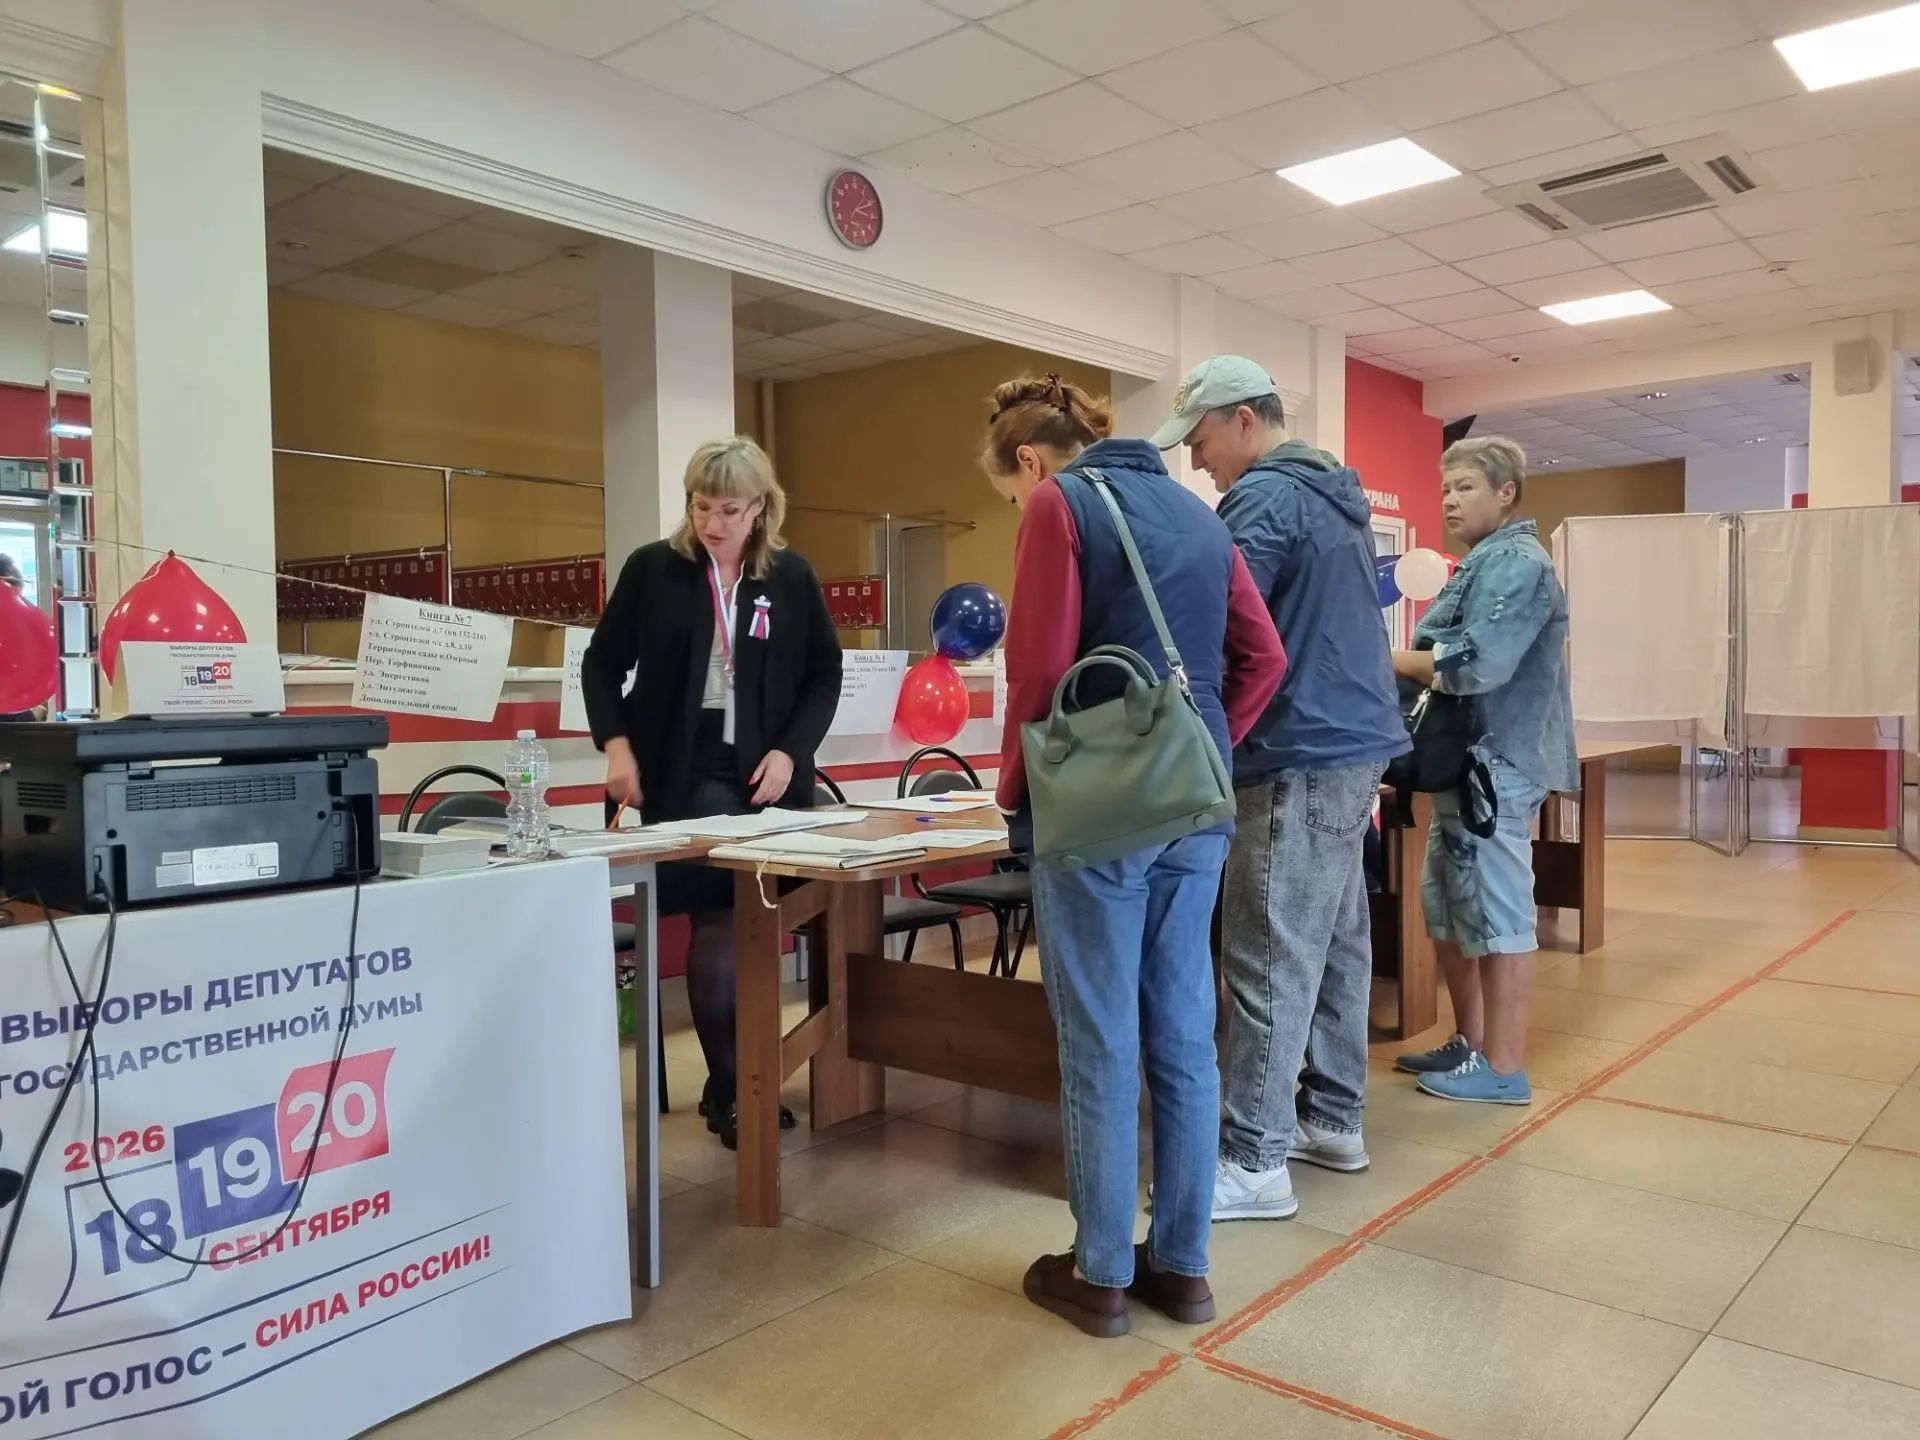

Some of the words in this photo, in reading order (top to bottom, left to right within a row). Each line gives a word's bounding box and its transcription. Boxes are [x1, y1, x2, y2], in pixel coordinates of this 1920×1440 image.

[1362, 488, 1400, 511] ХРАНА
[370, 618, 382, 626] ул.
[419, 609, 450, 621] Книга
[453, 613, 464, 623] №
[467, 616, 472, 624] 7
[366, 656, 384, 665] Пер.
[368, 642, 416, 656] Территория
[418, 651, 438, 659] сады
[184, 676, 197, 686] 18
[198, 670, 212, 680] 19
[214, 666, 230, 676] 20
[361, 682, 374, 690] ул.
[360, 694, 430, 708] Дополнительный
[1, 985, 193, 1045] ВЫБОРЫ
[204, 946, 413, 1011] ДЕПУТАТОВ
[0, 1005, 331, 1099] ГОСУДАРСТВЕННОЙ
[338, 992, 423, 1032] ДУМЫ
[64, 1124, 165, 1173] 2026
[85, 1198, 178, 1275] 18
[188, 1137, 272, 1208] 19
[286, 1080, 377, 1154] 20
[209, 1190, 391, 1272] СЕНТЯБРЯ
[65, 1346, 212, 1409] ГОЛОС
[255, 1292, 349, 1348] СИЛА
[358, 1235, 491, 1309] РОССИИ!
